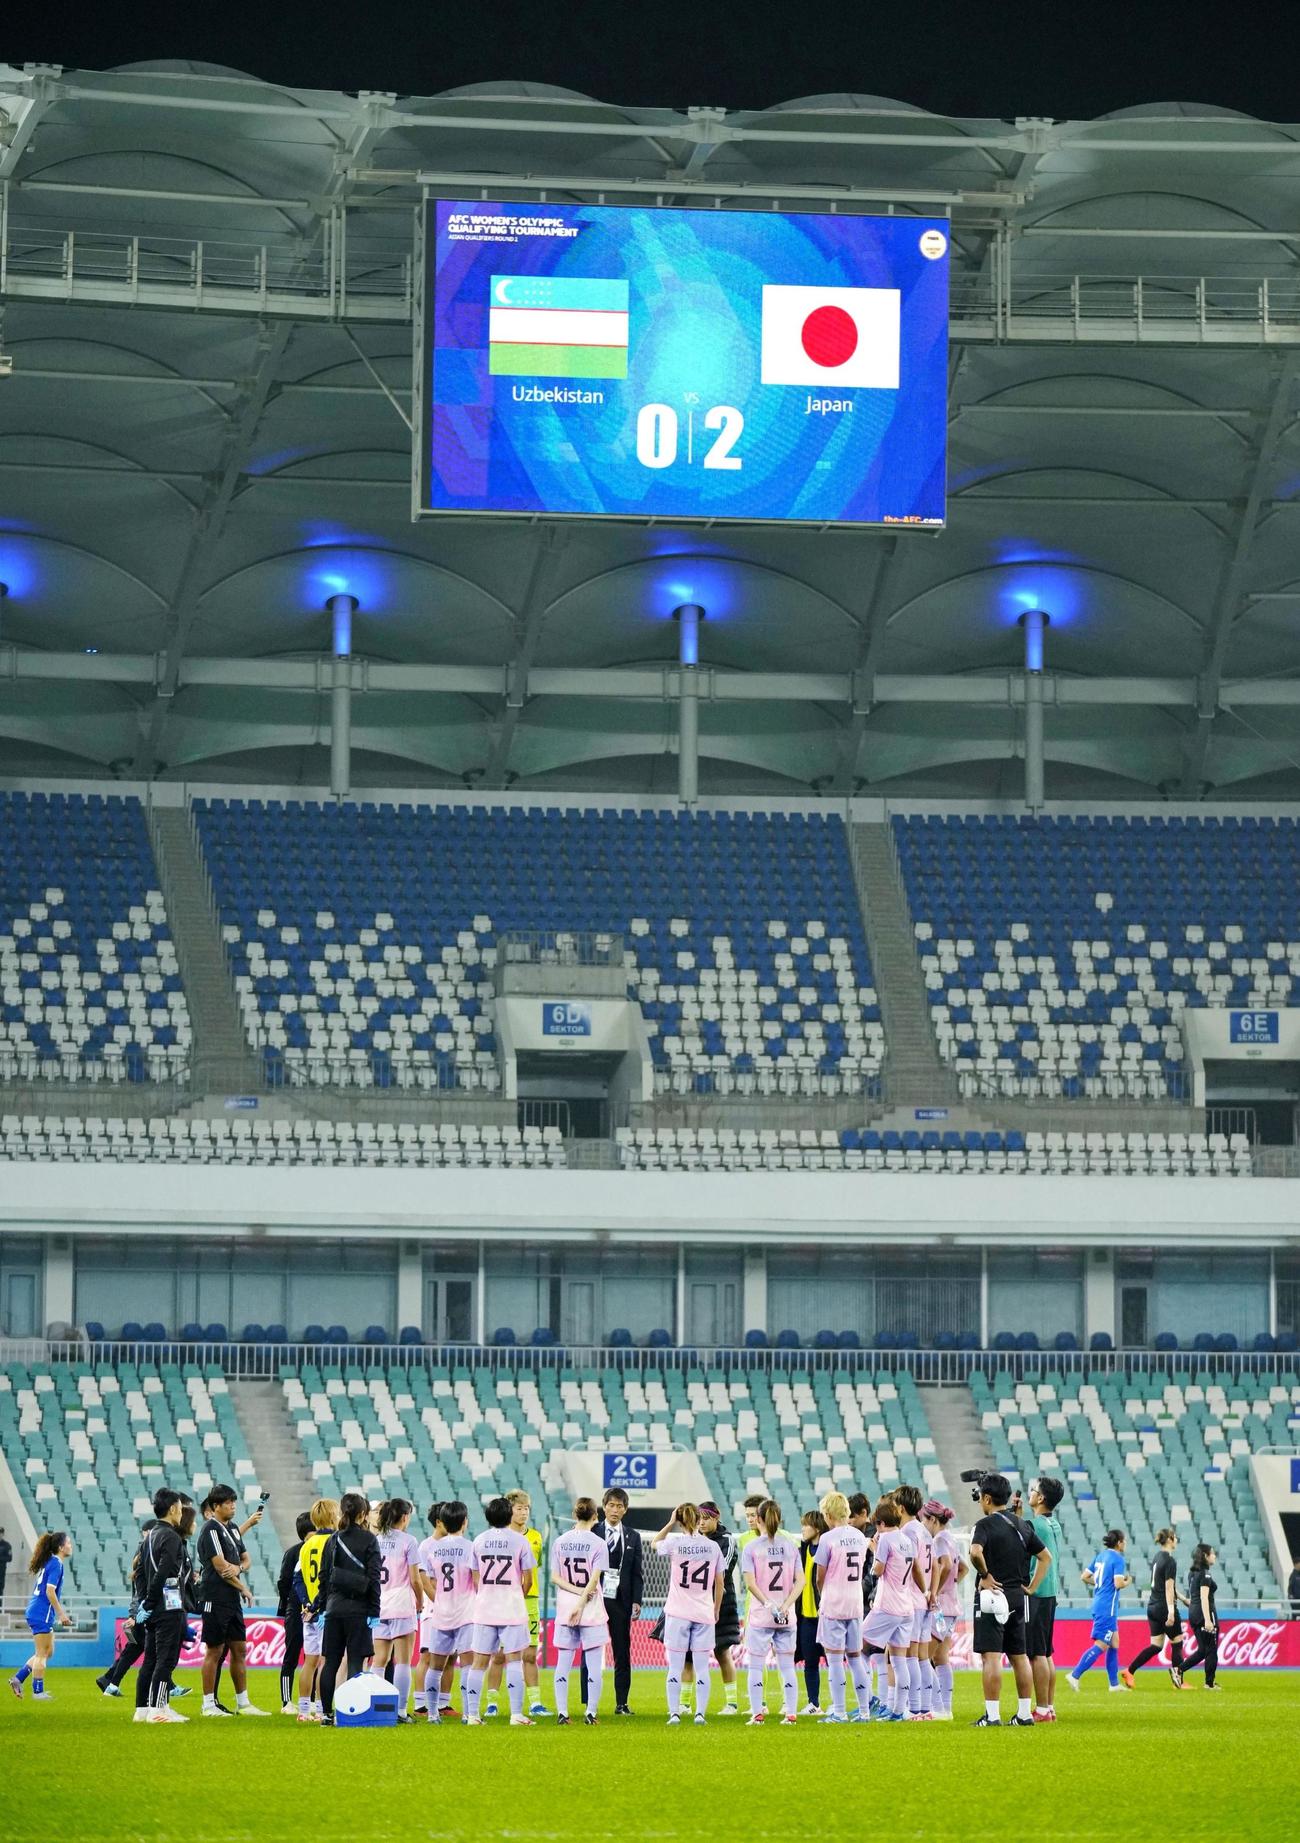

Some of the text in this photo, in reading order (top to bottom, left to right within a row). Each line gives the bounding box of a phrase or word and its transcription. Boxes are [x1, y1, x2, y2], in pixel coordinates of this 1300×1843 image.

[448, 224, 578, 237] QUALIFYING TOURNAMENT
[449, 215, 564, 227] AFC WOMEN'S OLYMPIC
[512, 385, 604, 404] Uzbekistan
[804, 395, 853, 415] Japan
[636, 403, 744, 470] 0 2
[552, 1005, 581, 1024] 6D
[1240, 1014, 1268, 1032] 6E
[550, 1025, 585, 1033] SEKTOR
[1237, 1033, 1271, 1041] SEKTOR
[613, 1456, 647, 1478] 2C
[610, 1478, 649, 1487] SEKTOR
[484, 1540, 509, 1549] CHIBA
[768, 1547, 785, 1556] RISA
[310, 1549, 318, 1583] 5
[846, 1552, 859, 1581] 5
[925, 1544, 932, 1573] 3
[441, 1562, 455, 1592] 8
[481, 1555, 513, 1585] 22
[563, 1557, 590, 1588] 15
[680, 1561, 710, 1590] 14
[768, 1561, 783, 1591] 2
[902, 1557, 913, 1585] 7
[1158, 1621, 1287, 1666] oc-Cola
